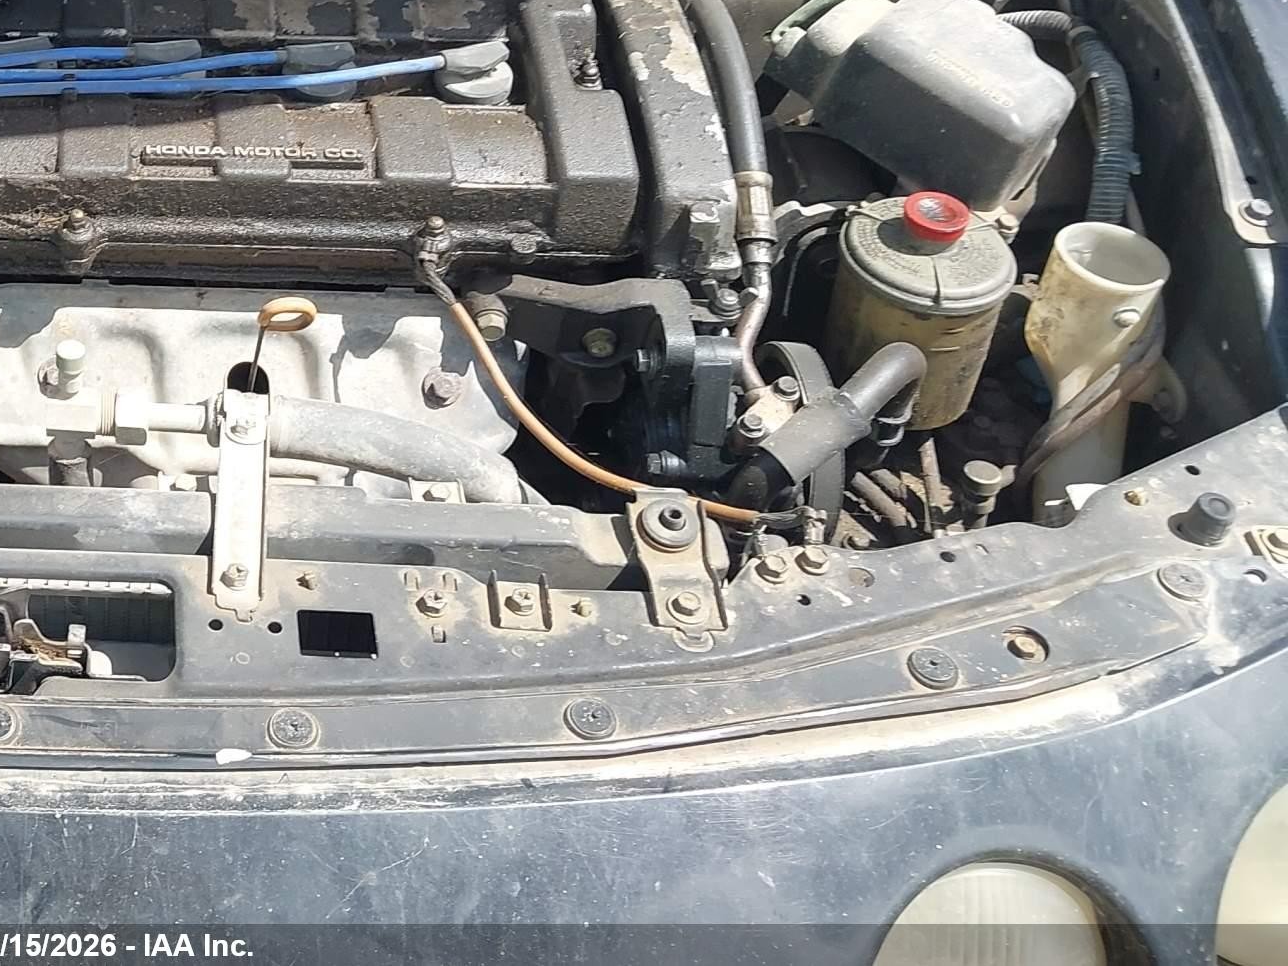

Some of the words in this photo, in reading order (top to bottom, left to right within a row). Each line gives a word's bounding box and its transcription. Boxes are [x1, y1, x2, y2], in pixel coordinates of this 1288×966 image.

[145, 144, 226, 156] HONDA
[234, 145, 317, 158] MOTOR
[324, 147, 363, 158] CO.
